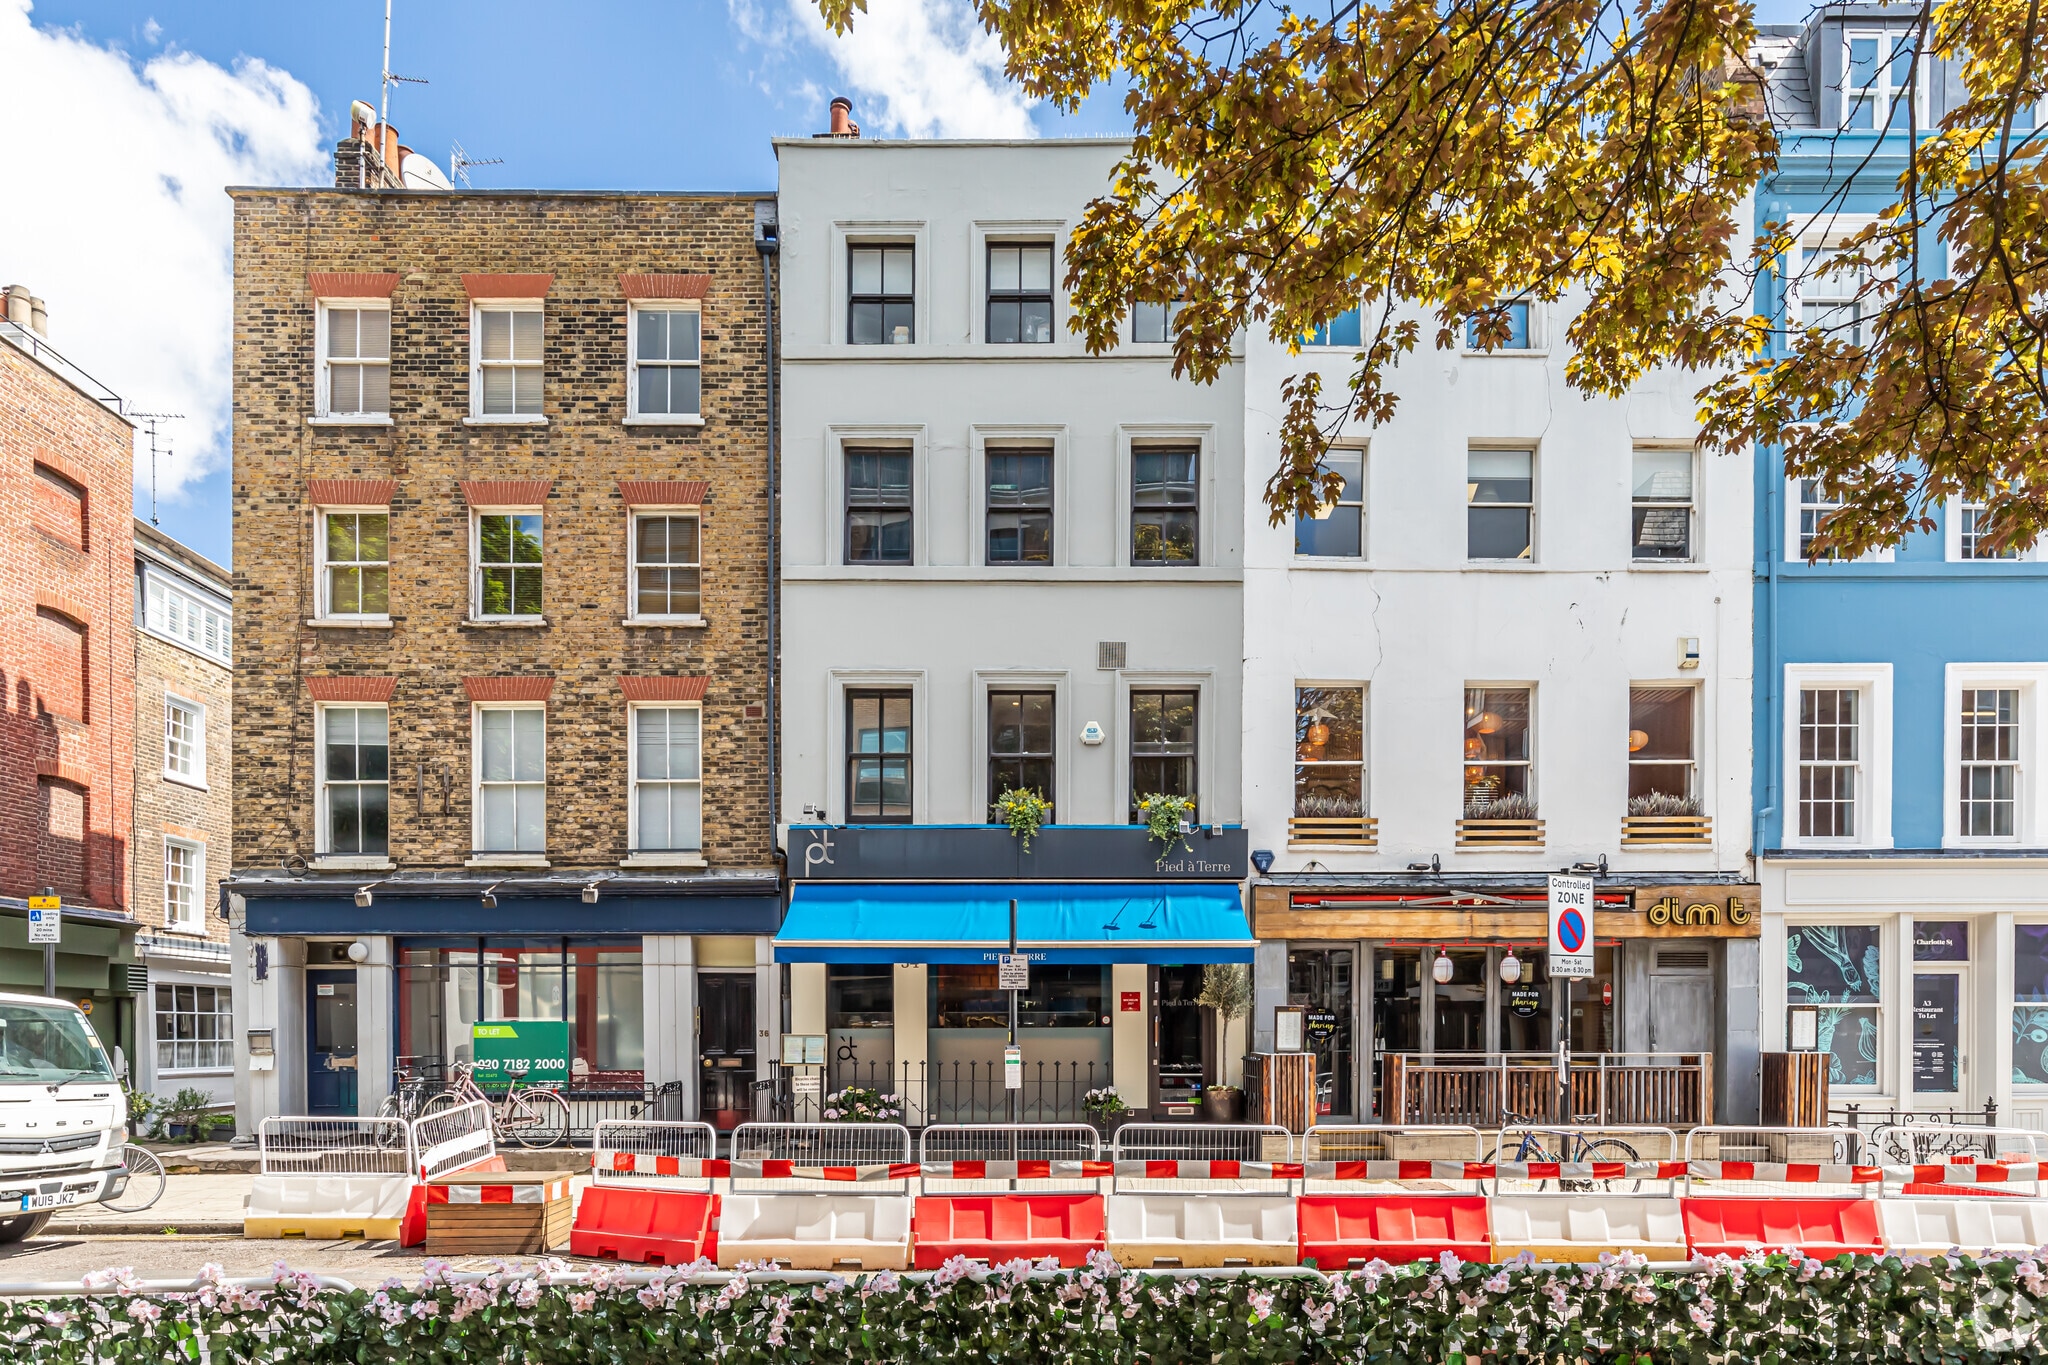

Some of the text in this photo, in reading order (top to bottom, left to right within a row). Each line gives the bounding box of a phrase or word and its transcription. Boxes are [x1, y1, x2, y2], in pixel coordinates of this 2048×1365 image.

[1156, 859, 1231, 873] Pied à Terre
[1552, 878, 1591, 890] Controlled
[1557, 891, 1585, 905] ZONE
[1647, 896, 1752, 926] dim t
[983, 953, 999, 961] PIE
[1512, 997, 1538, 1009] sharing
[1308, 1020, 1335, 1033] sharing
[478, 1059, 565, 1070] 020 7182 2000
[31, 1193, 75, 1208] WU19 JKZ
